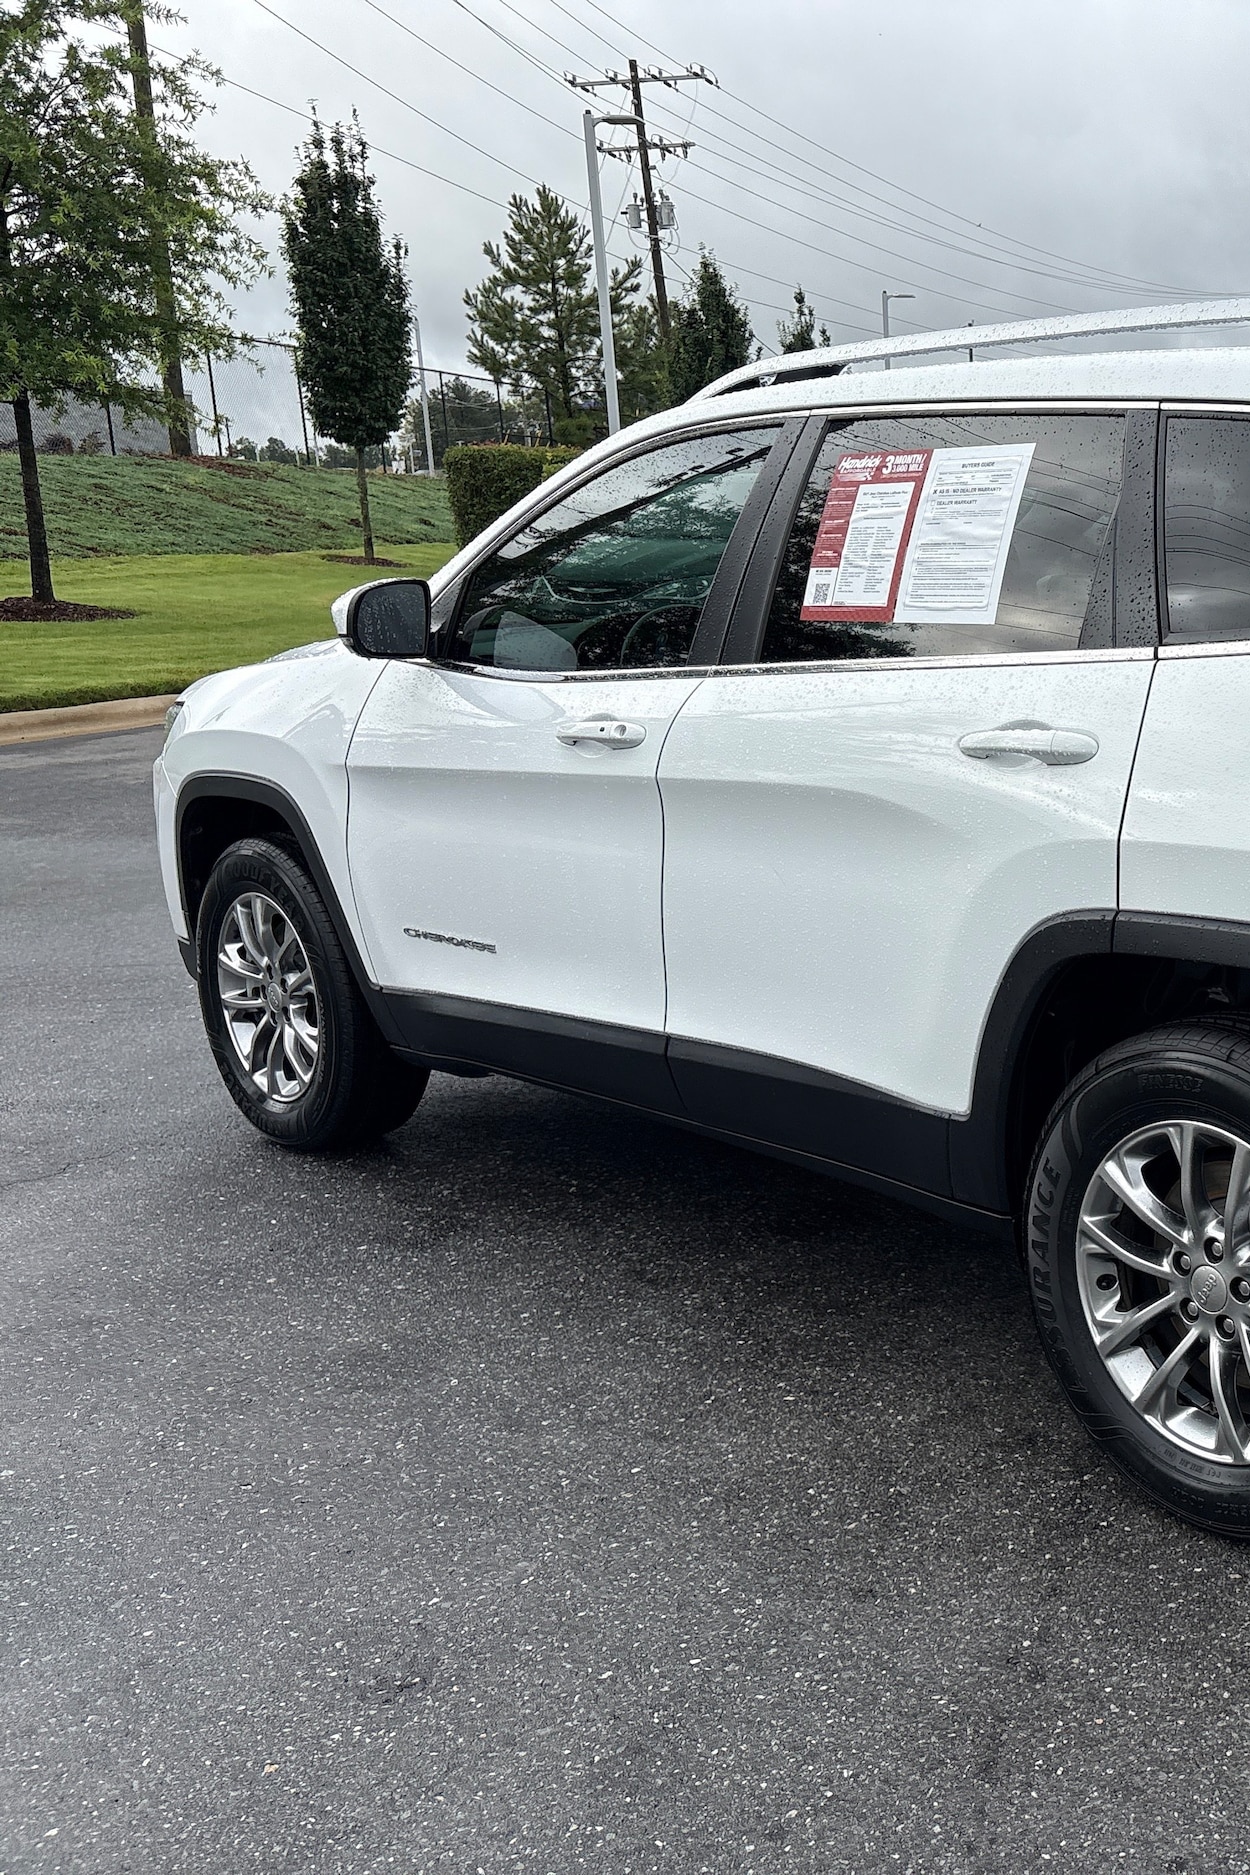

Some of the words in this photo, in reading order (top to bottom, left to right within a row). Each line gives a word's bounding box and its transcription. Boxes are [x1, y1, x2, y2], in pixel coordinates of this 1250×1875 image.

[837, 454, 883, 473] Hendrick
[882, 454, 896, 475] 3
[402, 927, 498, 955] CHEROKEE
